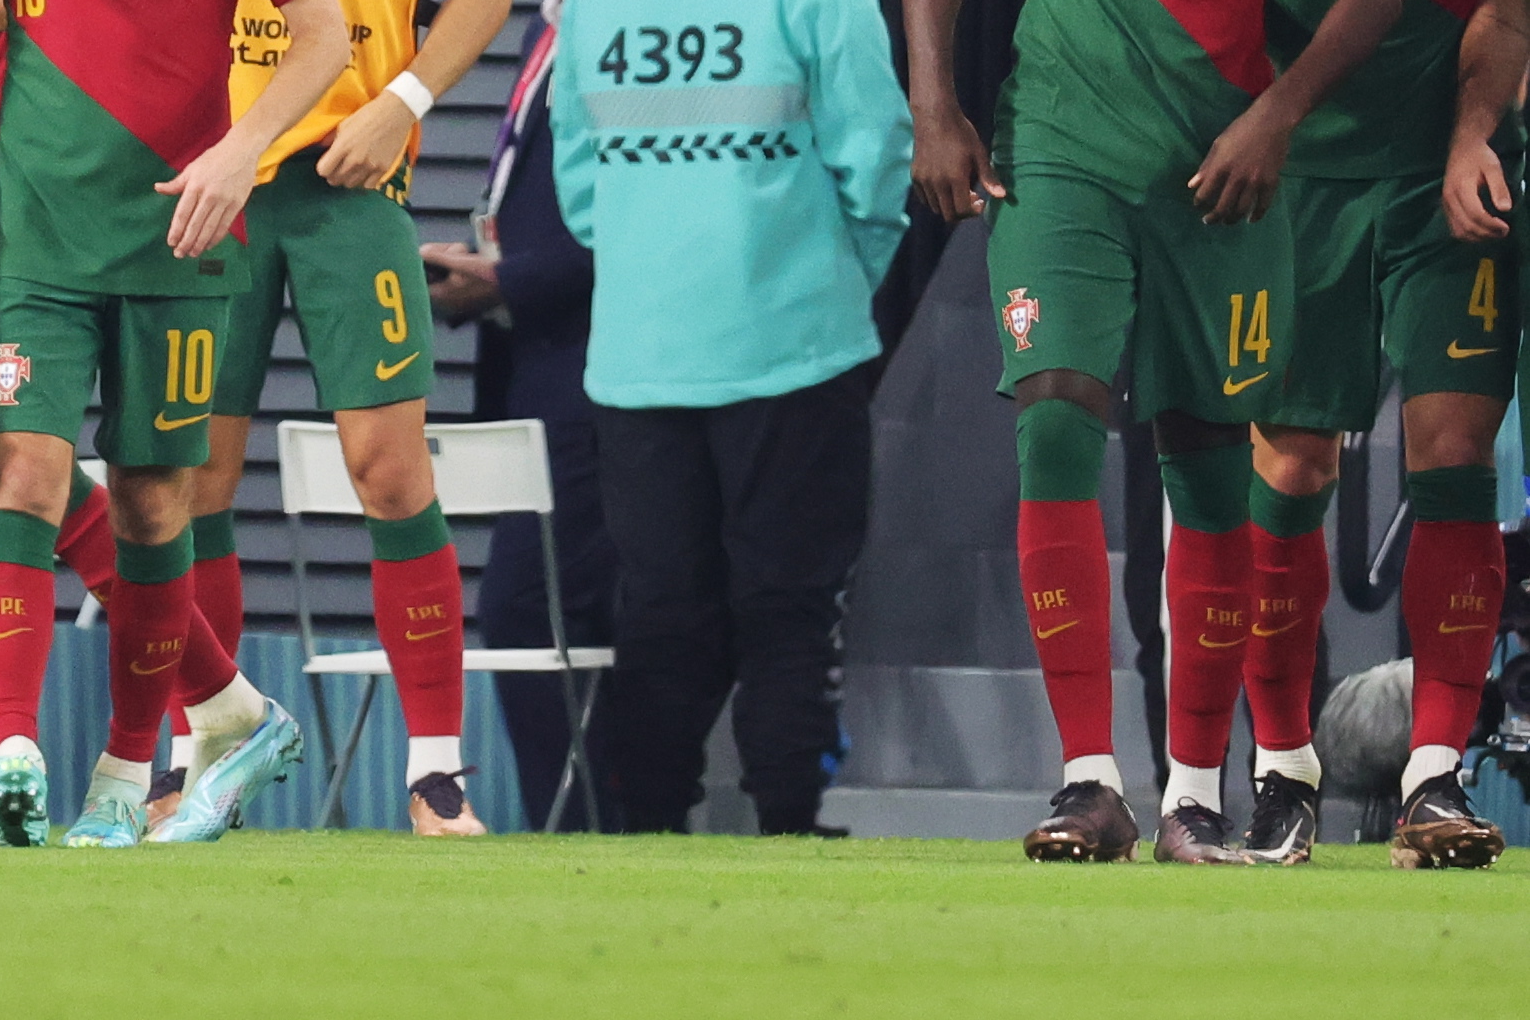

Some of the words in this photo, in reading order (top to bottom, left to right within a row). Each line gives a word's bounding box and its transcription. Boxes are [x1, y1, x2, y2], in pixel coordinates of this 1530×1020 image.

[598, 22, 745, 86] 4393
[374, 269, 409, 345] 9
[1227, 288, 1272, 368] 14
[1468, 257, 1499, 333] 4
[165, 328, 215, 405] 10
